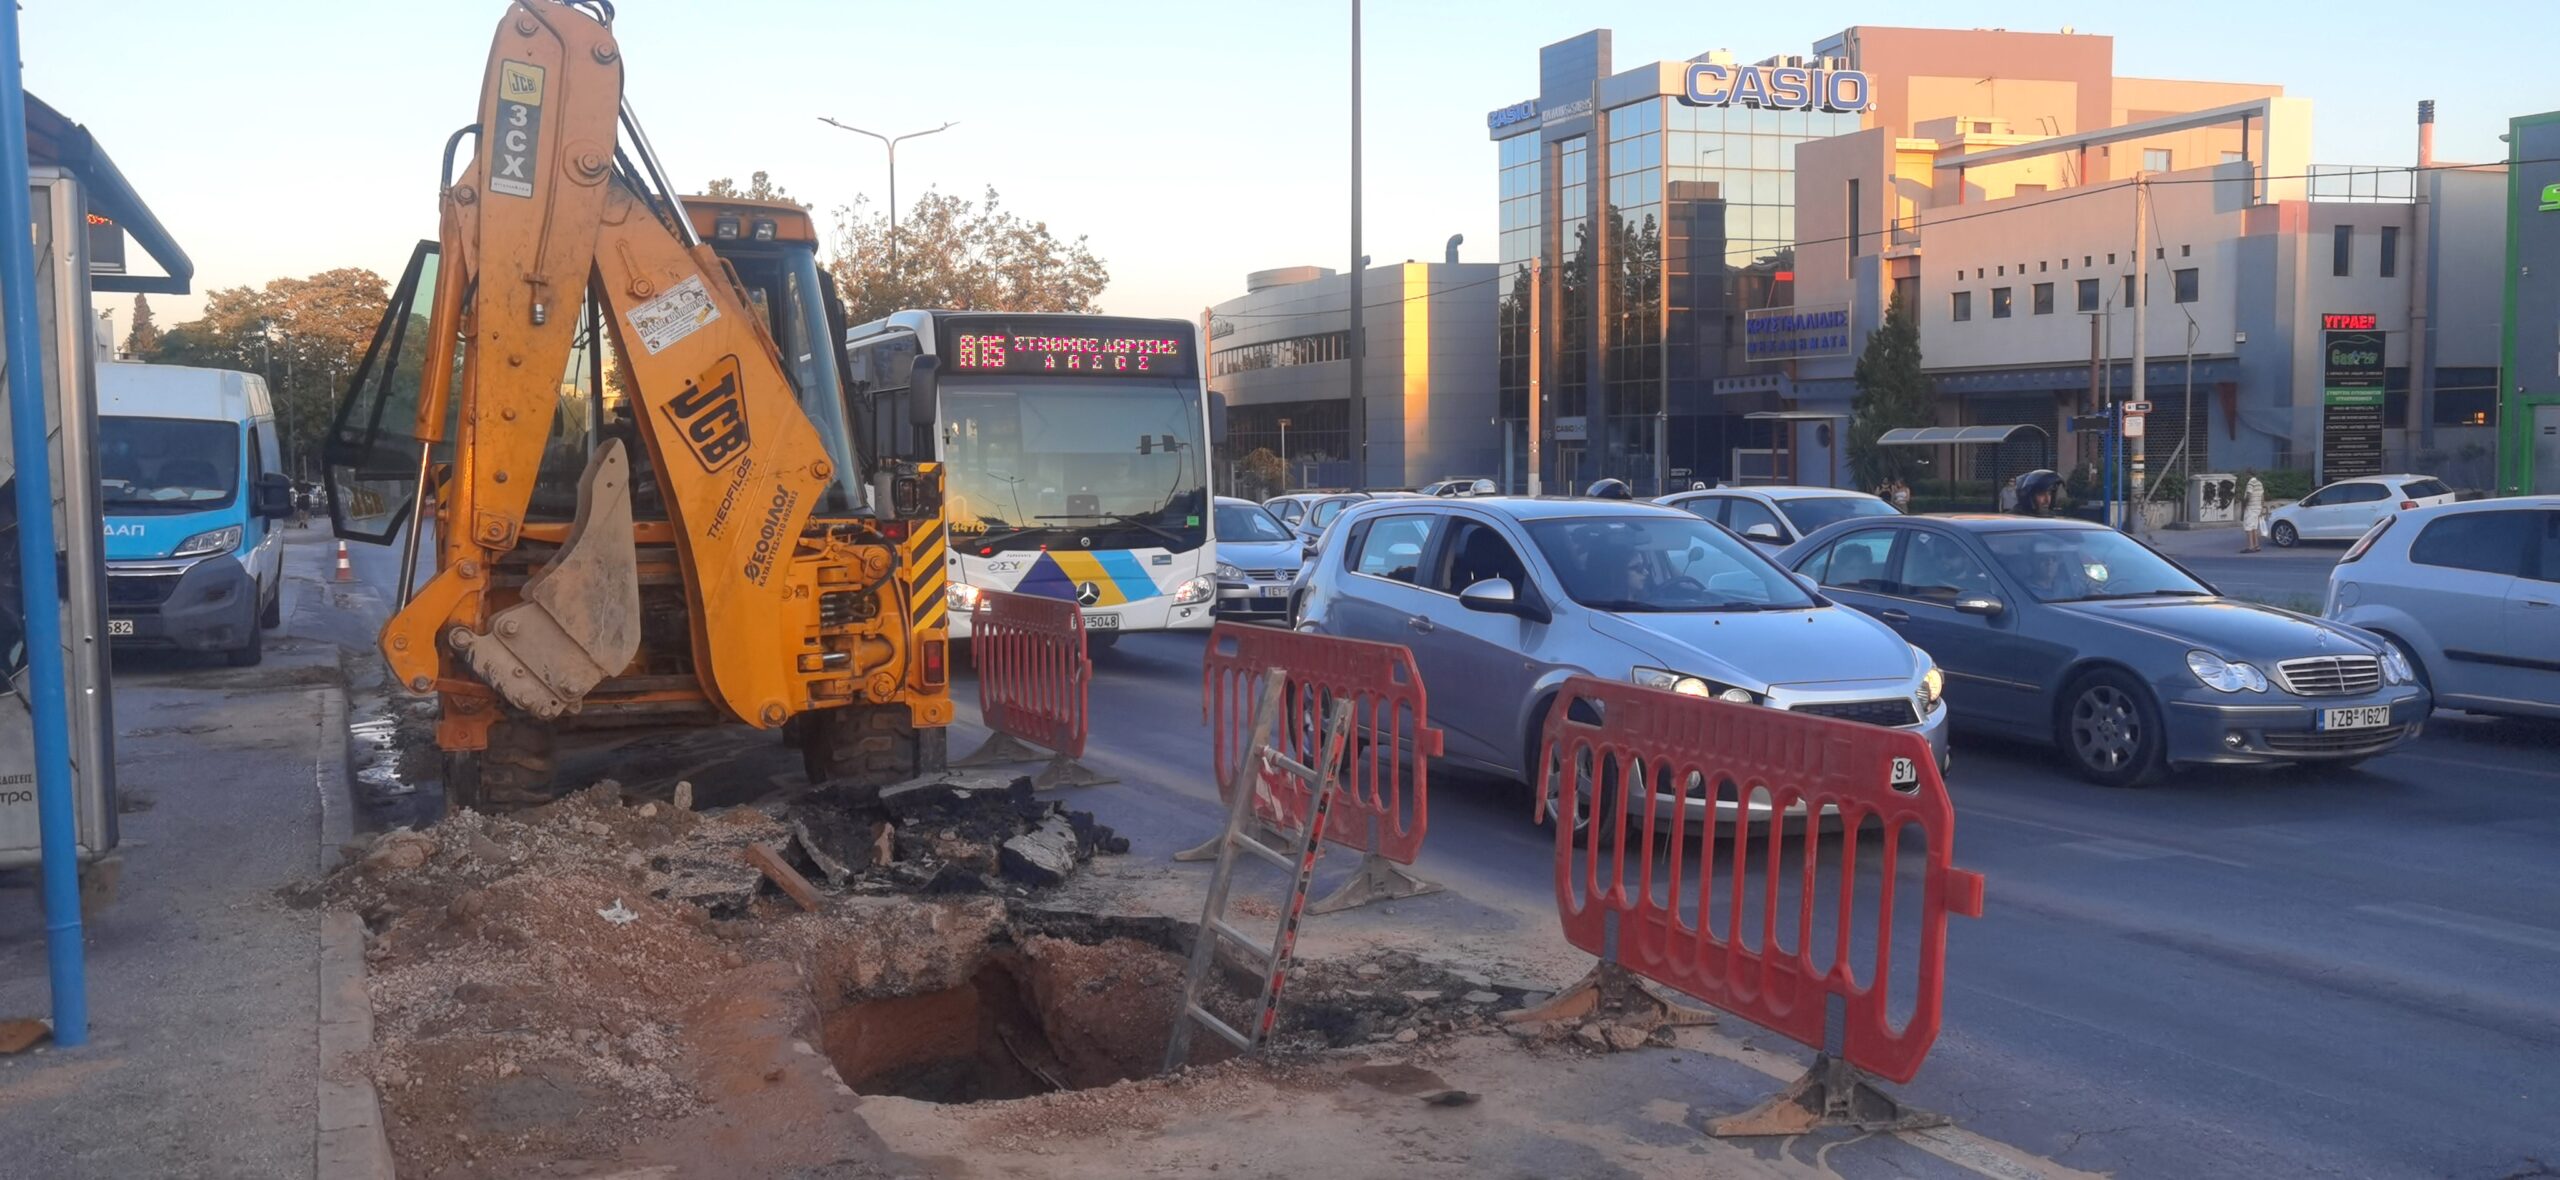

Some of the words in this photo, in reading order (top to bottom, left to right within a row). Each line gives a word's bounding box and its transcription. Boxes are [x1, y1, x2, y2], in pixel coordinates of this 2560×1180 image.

[512, 73, 536, 92] JCB
[1685, 63, 1869, 111] CASIO
[1488, 100, 1534, 128] CASIO
[501, 104, 528, 178] 3CX
[668, 371, 749, 464] JCB
[707, 456, 752, 539] THEOFILOS
[1892, 760, 1914, 780] 91
